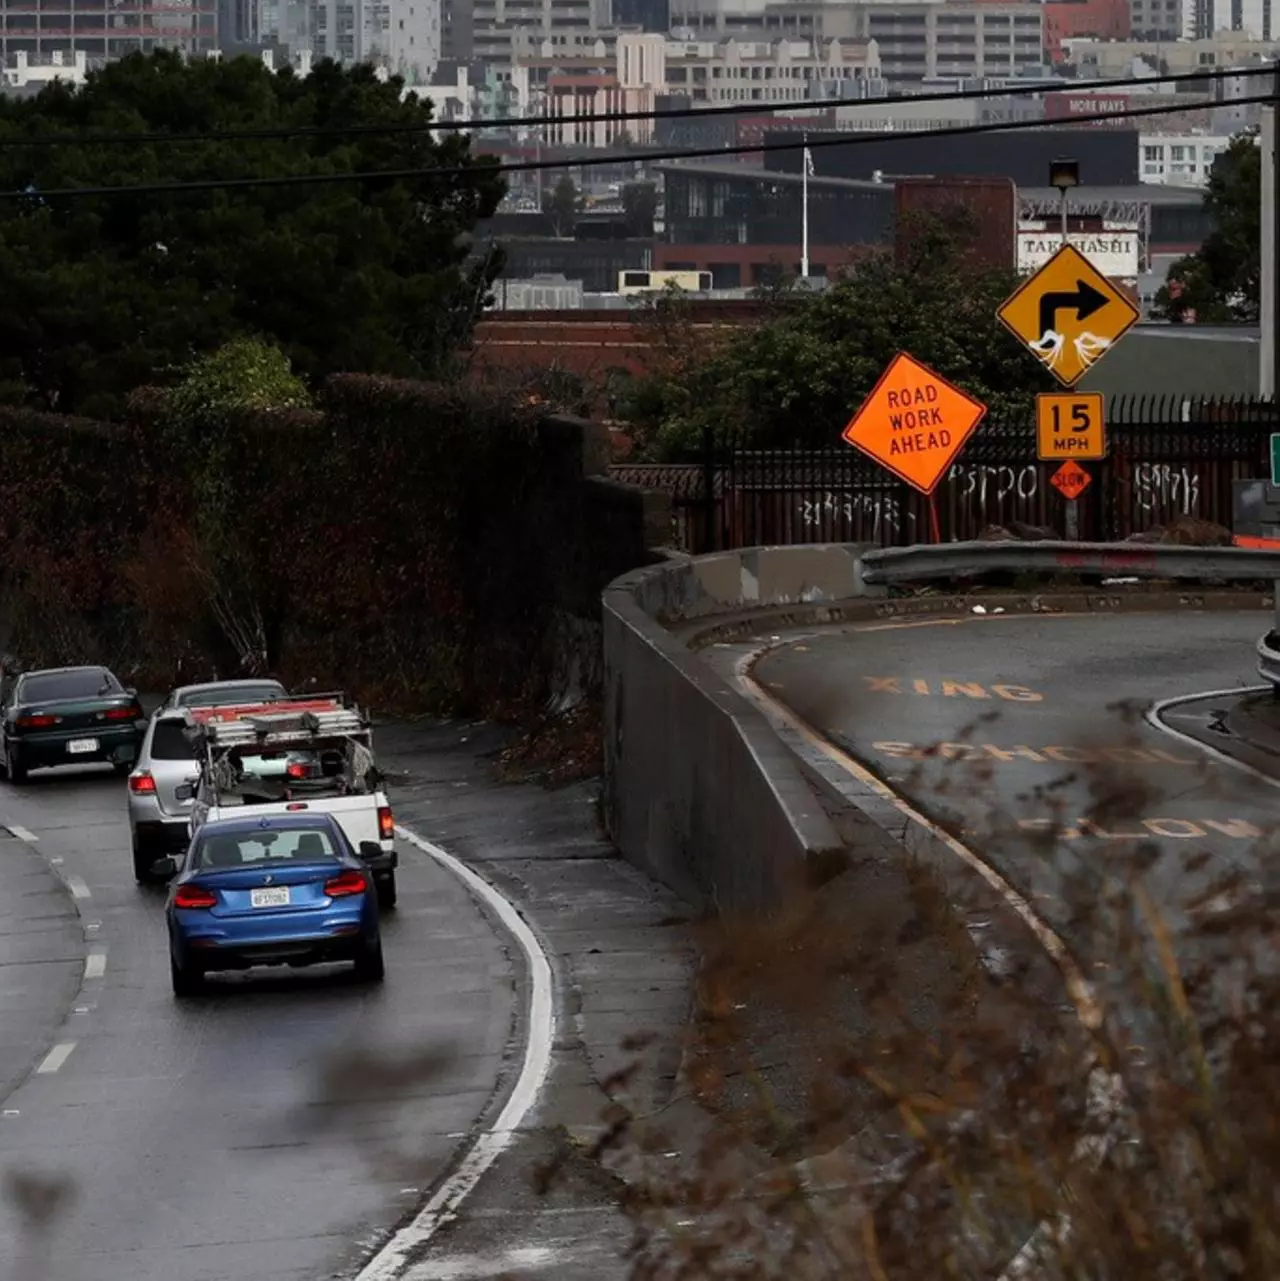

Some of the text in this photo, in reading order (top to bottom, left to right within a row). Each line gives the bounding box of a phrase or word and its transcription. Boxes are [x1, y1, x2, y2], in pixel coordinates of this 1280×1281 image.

[1069, 99, 1126, 113] MORE WAYS
[1023, 239, 1132, 254] TAKHASHI
[887, 384, 938, 409] ROAD
[889, 407, 943, 432] WORK
[1051, 404, 1091, 433] 15
[889, 430, 952, 456] AHEAD
[1053, 438, 1088, 451] MPH
[1055, 472, 1085, 487] SLOW
[863, 675, 1045, 702] XING
